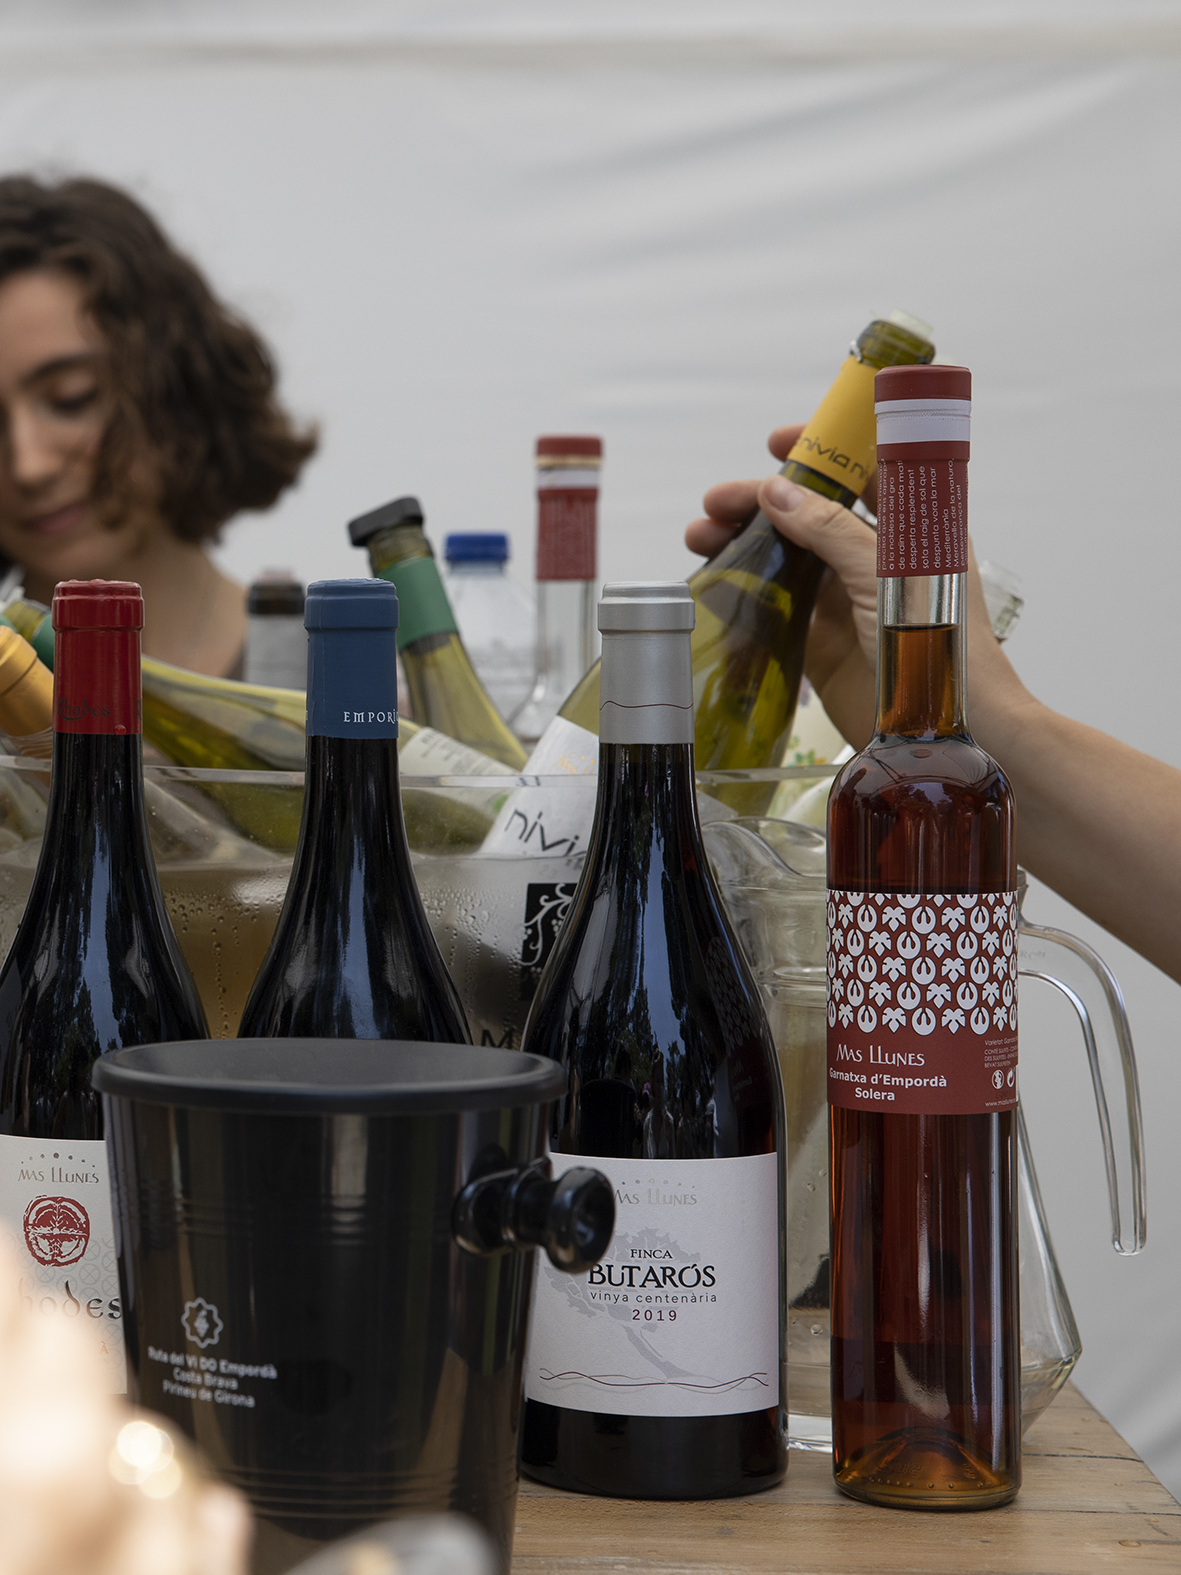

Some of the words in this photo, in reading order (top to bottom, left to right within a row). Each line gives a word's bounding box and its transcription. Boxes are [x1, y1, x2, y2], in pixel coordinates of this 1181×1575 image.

[918, 466, 927, 486] que
[930, 467, 938, 487] mar
[897, 485, 905, 511] cada
[907, 469, 917, 526] resplendent
[918, 488, 927, 501] sol
[930, 490, 938, 498] la
[949, 495, 957, 504] la
[919, 503, 927, 516] de
[931, 501, 939, 522] vora
[949, 506, 957, 519] de
[899, 513, 907, 531] que
[919, 519, 929, 536] raig
[920, 539, 929, 547] el
[933, 525, 942, 568] despunta
[942, 509, 952, 568] Mediterrània
[950, 522, 959, 567] Meravella
[888, 552, 895, 561] la
[909, 528, 918, 569] desperta
[898, 557, 906, 570] de
[921, 549, 929, 569] sota
[58, 697, 111, 721] Rhodes
[829, 1067, 867, 1084] Garnatxa
[855, 1087, 895, 1101] Solera
[630, 1249, 673, 1259] FINCA
[588, 1263, 716, 1288] BUTARÓS
[590, 1290, 629, 1304] vinya
[636, 1293, 717, 1303] centenària
[632, 1309, 677, 1321] 2019
[199, 1356, 217, 1372] DO
